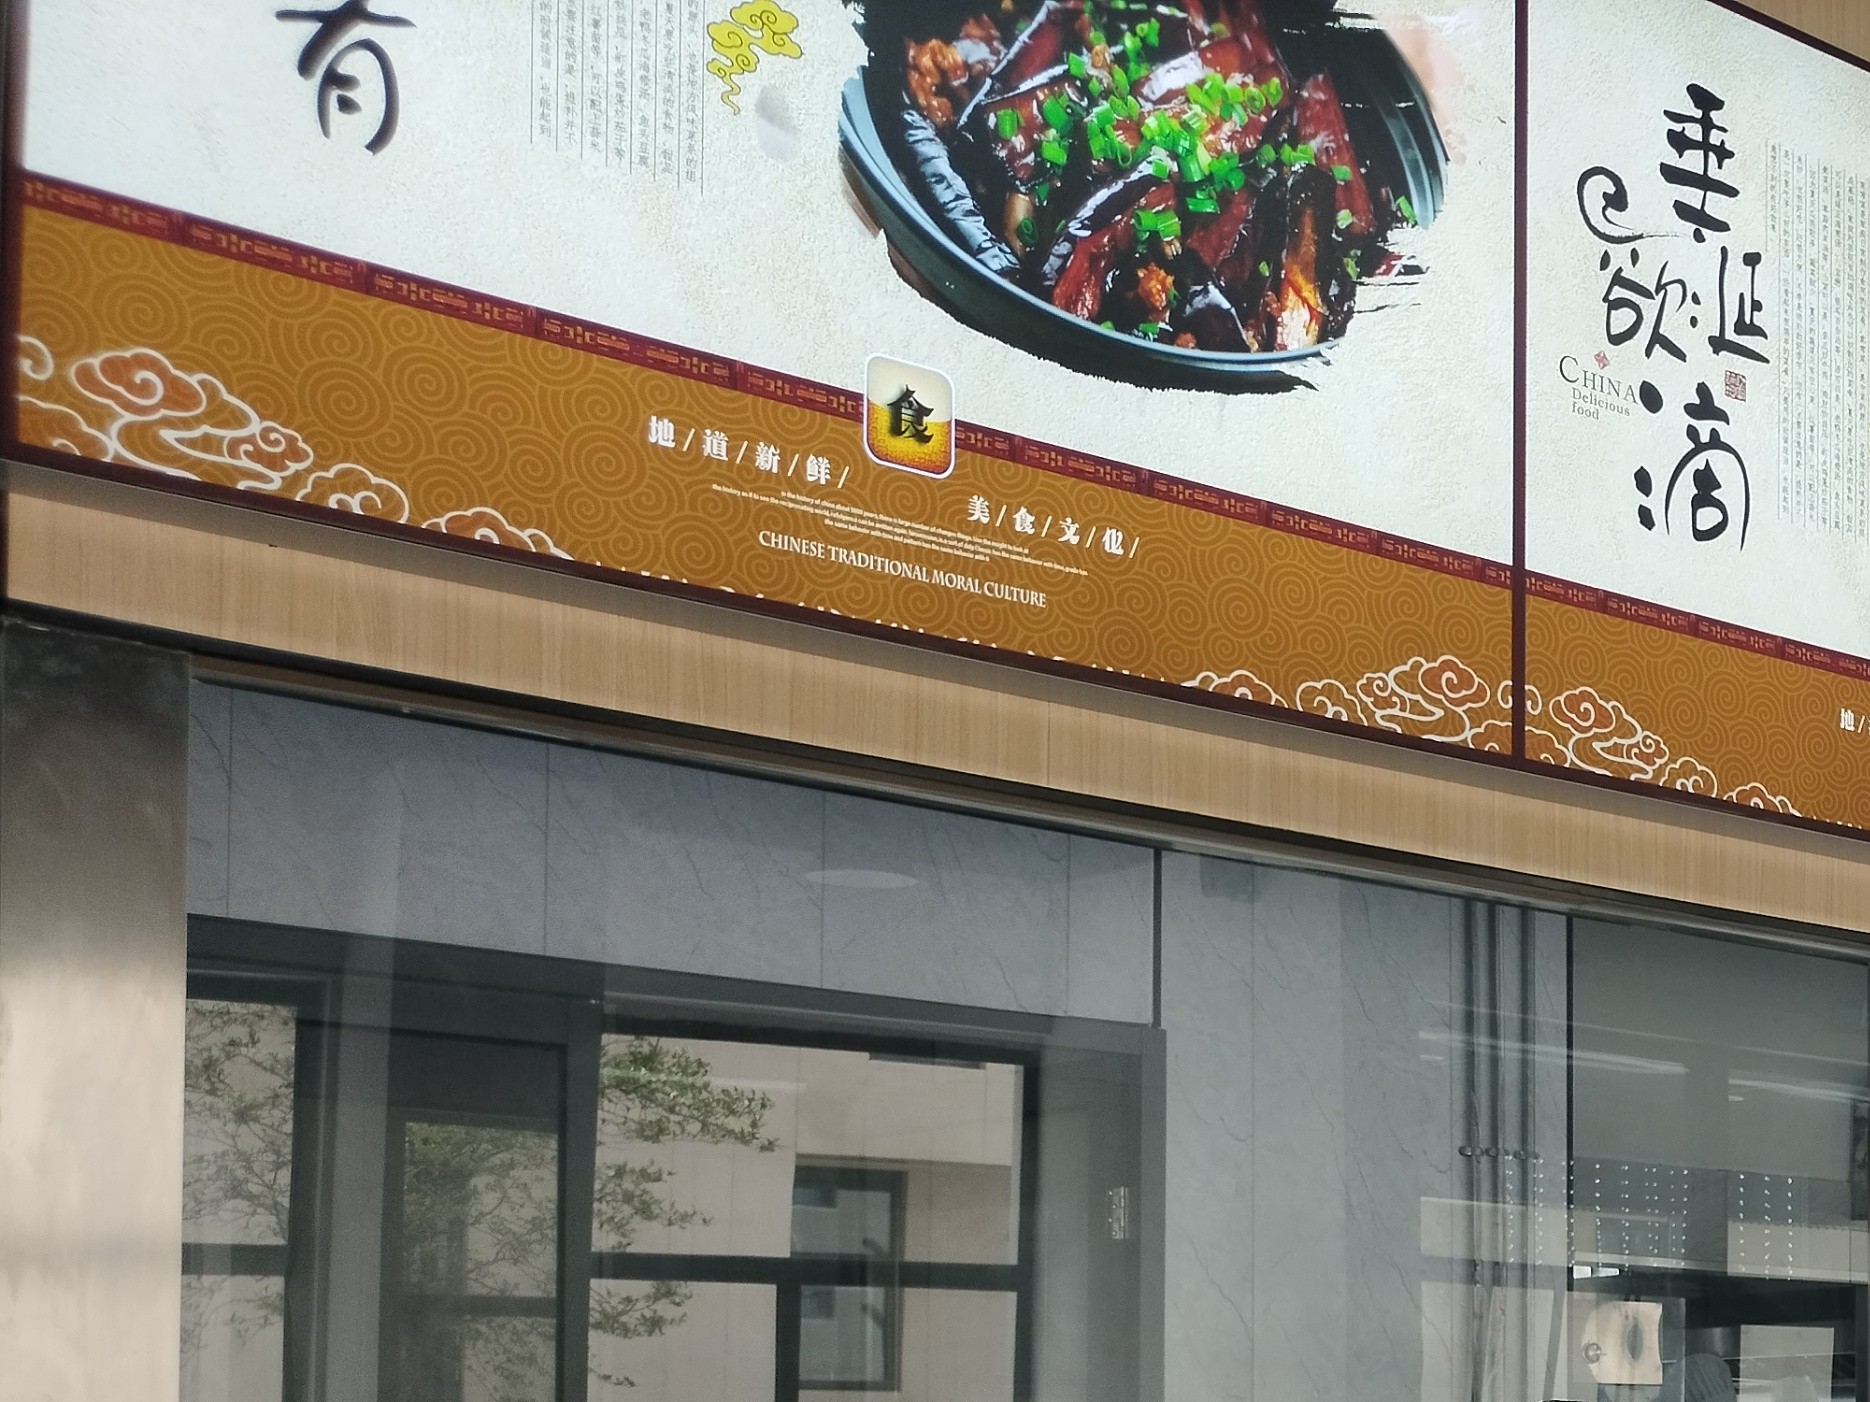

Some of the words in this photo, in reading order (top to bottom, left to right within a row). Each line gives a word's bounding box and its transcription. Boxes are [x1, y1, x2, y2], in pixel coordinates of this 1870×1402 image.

[275, 0, 418, 156] 有
[1559, 355, 1639, 405] CHINA
[1571, 386, 1631, 417] Delicious
[888, 384, 935, 445] 食
[1572, 401, 1600, 421] food
[758, 530, 825, 560] CHINESE
[827, 545, 930, 584] TRADITIONAL
[931, 570, 982, 594] MORAL
[983, 581, 1047, 609] CULTURE
